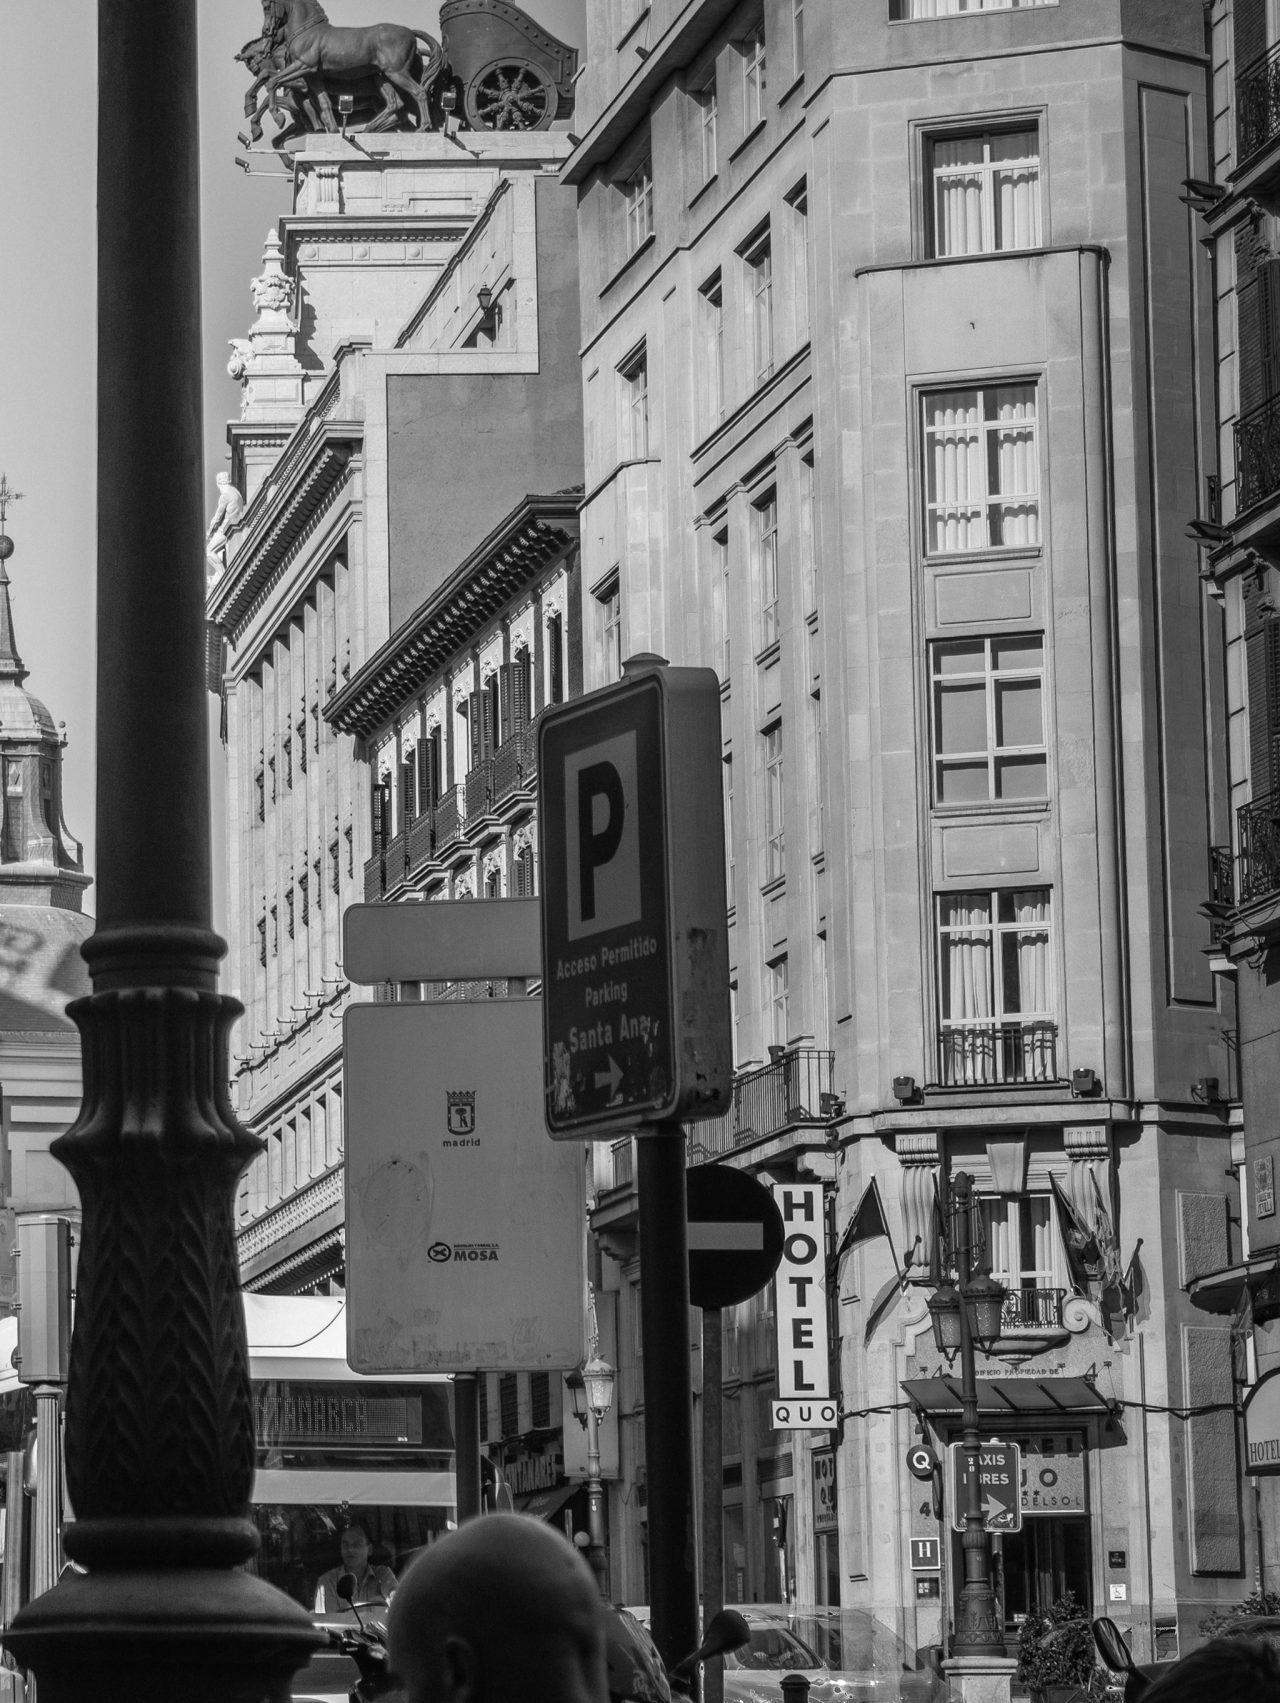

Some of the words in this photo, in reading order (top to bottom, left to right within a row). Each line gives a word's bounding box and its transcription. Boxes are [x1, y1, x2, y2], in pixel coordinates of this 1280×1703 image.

[578, 761, 625, 923] P
[556, 955, 598, 982] Acceso
[602, 936, 658, 968] Permitido
[586, 980, 629, 1009] Parking
[569, 1020, 614, 1054] Santa
[619, 1013, 650, 1042] Ana
[442, 1137, 481, 1148] madrid
[454, 1250, 499, 1262] MOSA
[783, 1190, 818, 1392] HOTEL
[775, 1406, 836, 1425] QUO
[912, 1451, 932, 1470] Q
[918, 1541, 932, 1558] H
